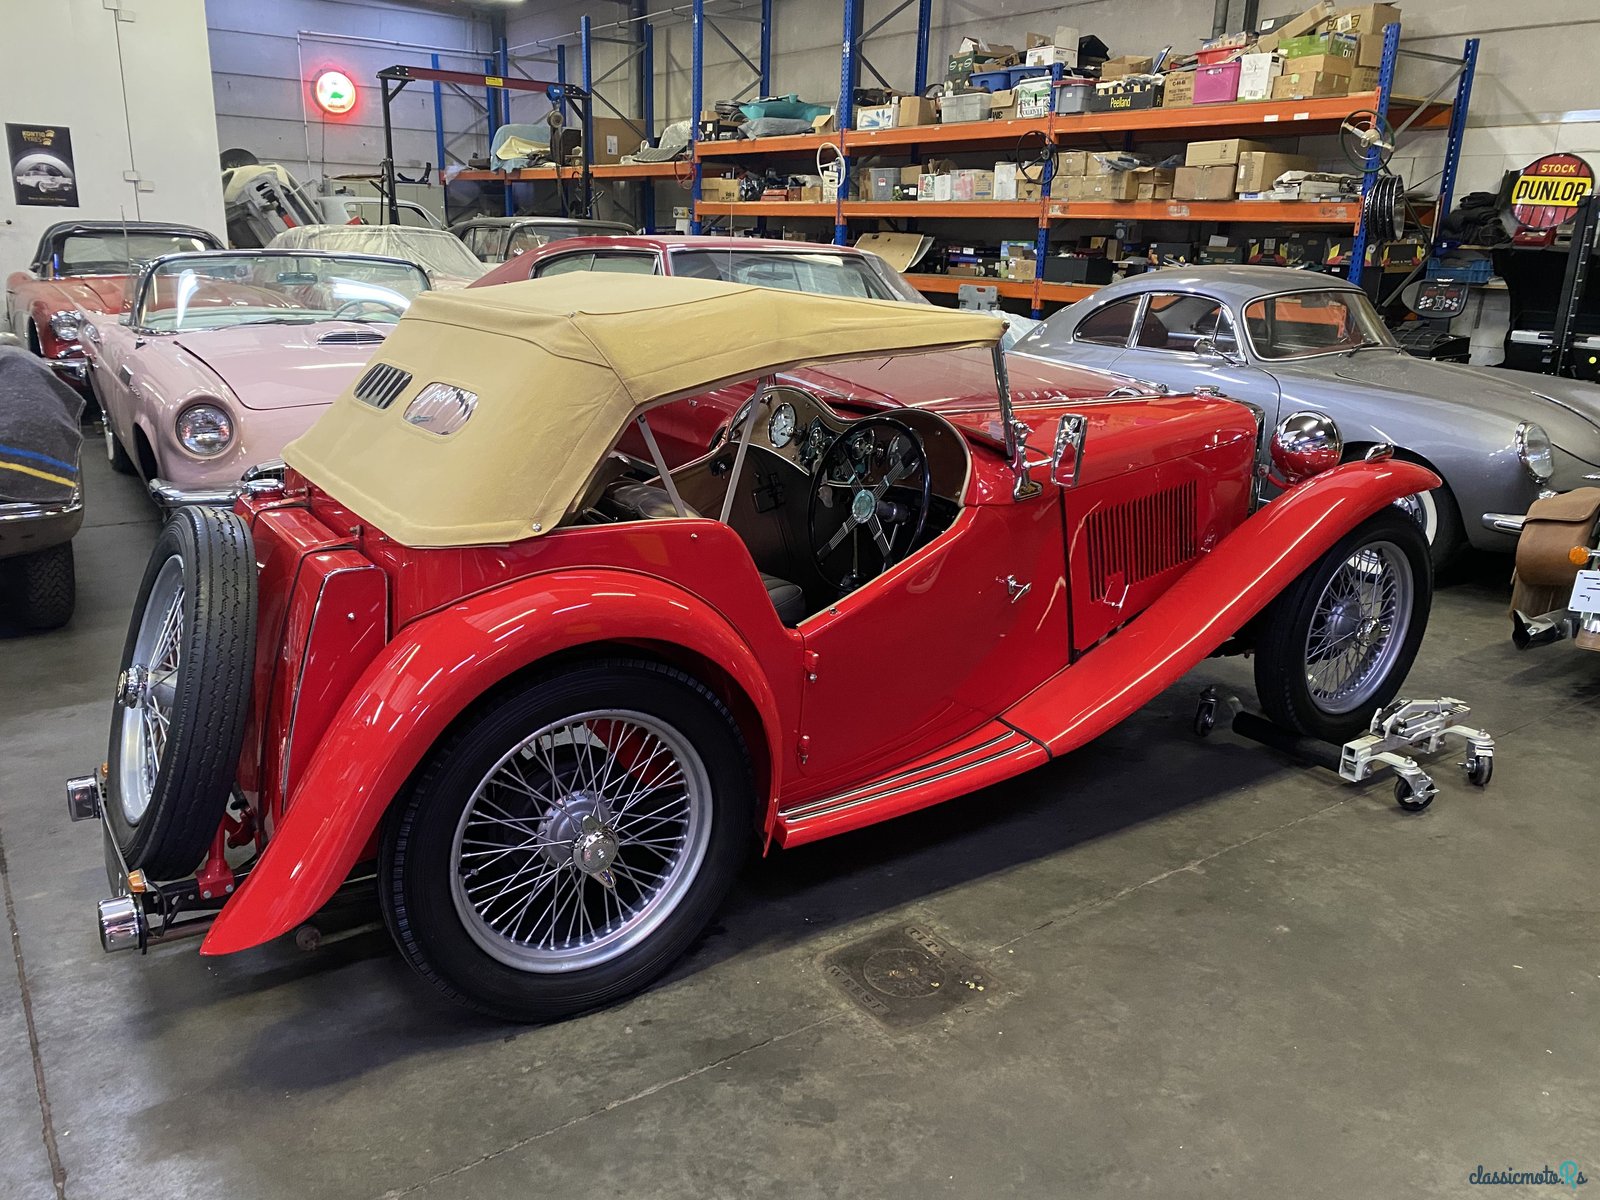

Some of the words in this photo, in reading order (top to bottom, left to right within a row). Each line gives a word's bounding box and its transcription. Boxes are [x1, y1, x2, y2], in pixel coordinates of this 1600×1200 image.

[1110, 96, 1131, 108] Peelland
[1541, 164, 1576, 173] STOCK
[1516, 180, 1587, 202] DUNLOP
